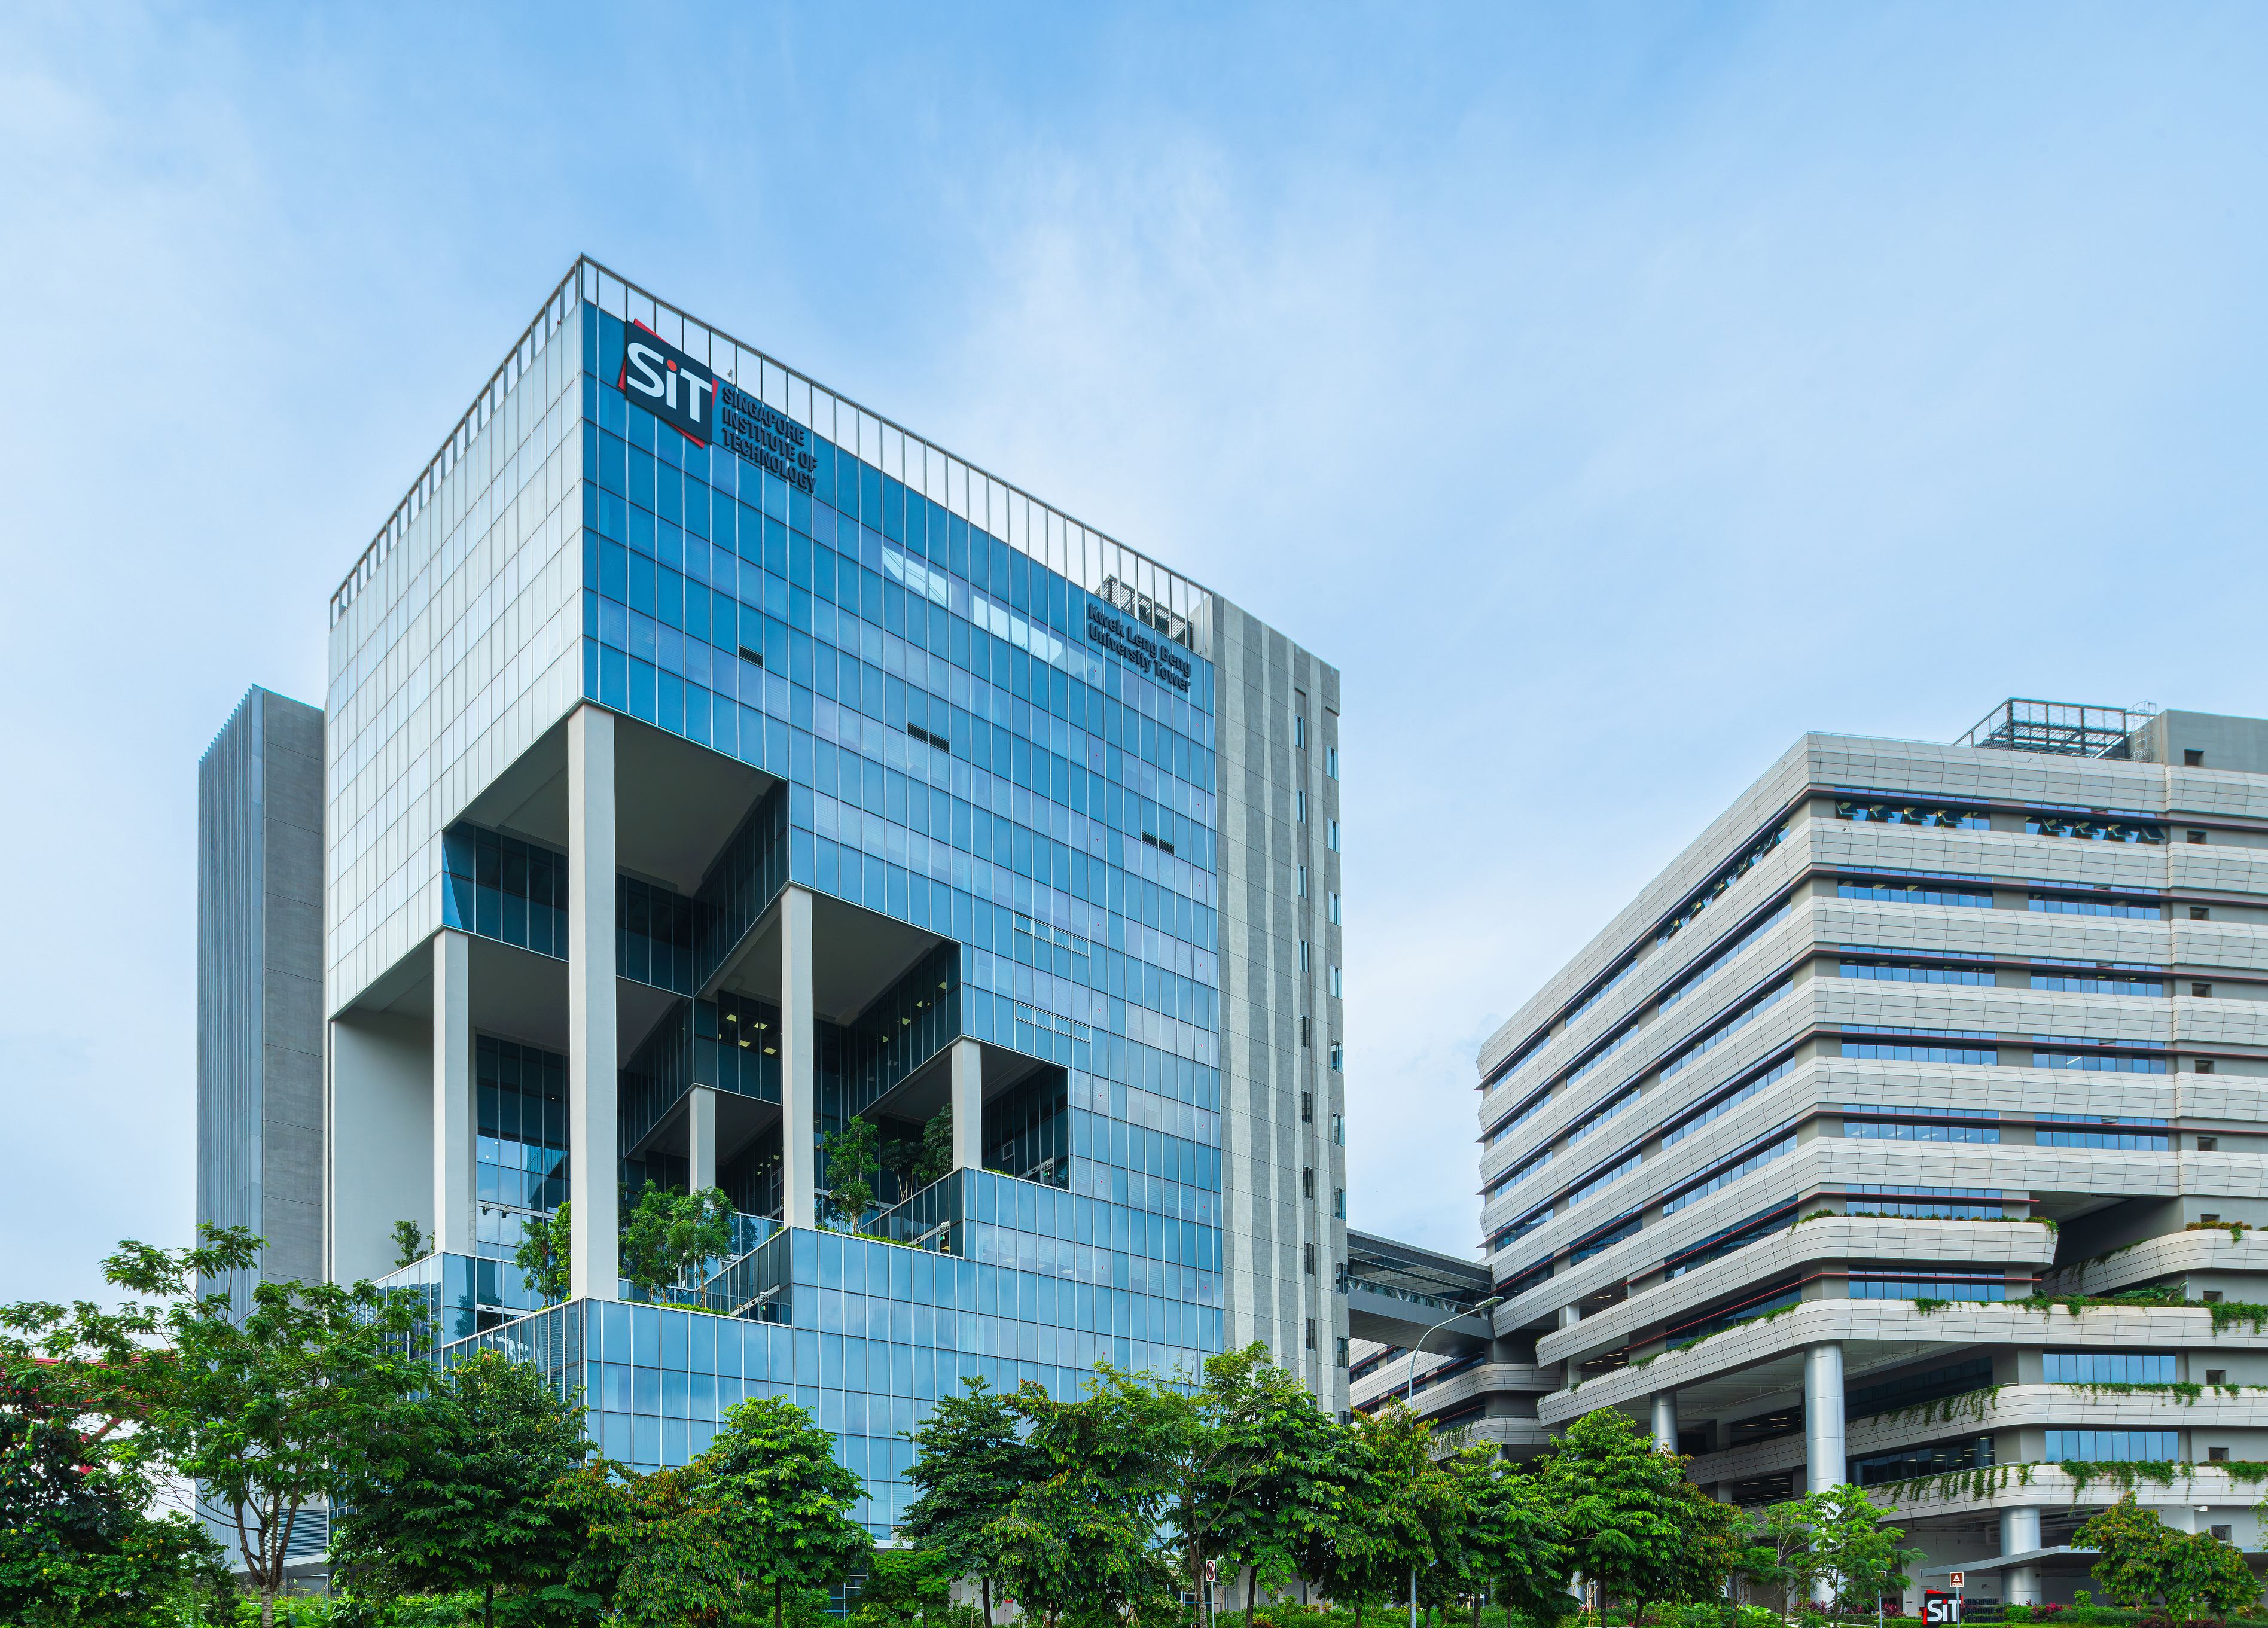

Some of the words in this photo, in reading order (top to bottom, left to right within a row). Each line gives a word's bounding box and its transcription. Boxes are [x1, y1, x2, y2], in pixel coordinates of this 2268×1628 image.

[627, 342, 712, 423] SiT
[723, 386, 805, 447] SINGAPORE
[723, 407, 795, 462] INSTITUTE
[798, 450, 818, 472] OF
[723, 427, 817, 493] TECHNOLOGY
[1089, 603, 1125, 638] Kwek
[1127, 626, 1158, 658] Leng
[1160, 645, 1191, 678] Beng
[1089, 623, 1152, 673] University
[1154, 659, 1191, 693] Tower
[1927, 1599, 1961, 1621] SiT
